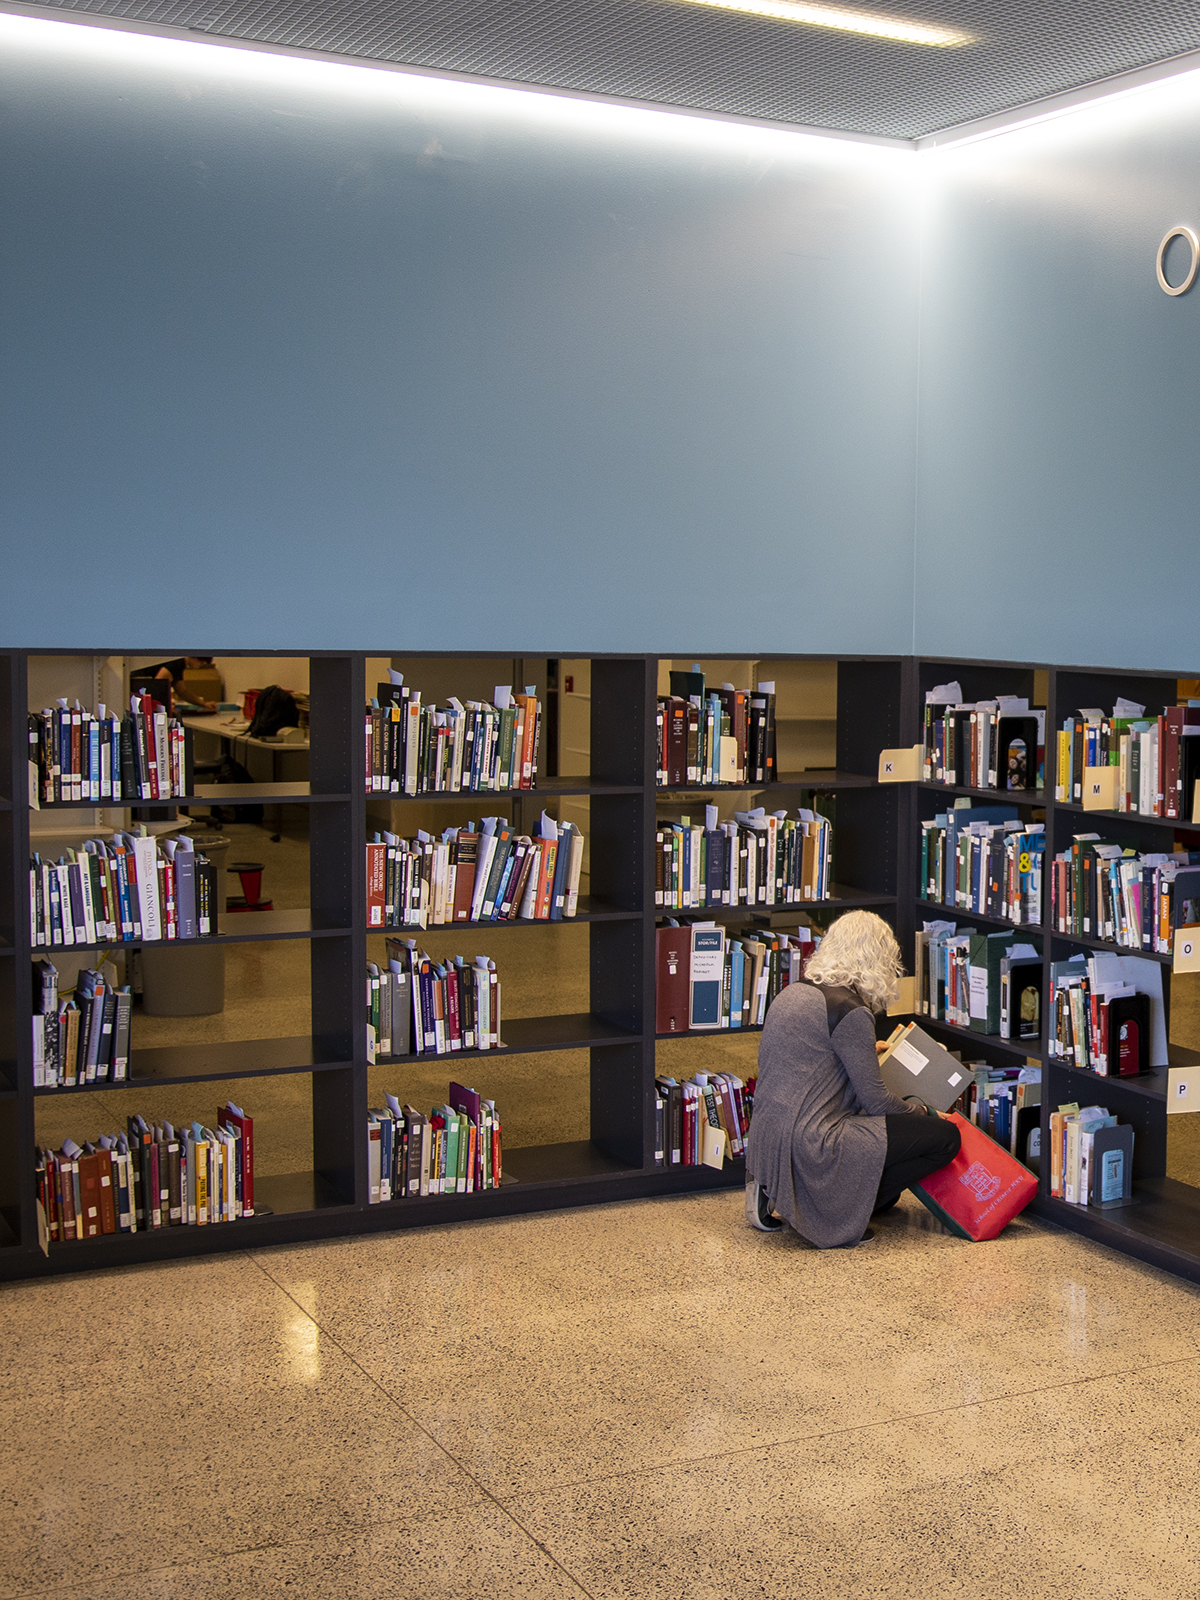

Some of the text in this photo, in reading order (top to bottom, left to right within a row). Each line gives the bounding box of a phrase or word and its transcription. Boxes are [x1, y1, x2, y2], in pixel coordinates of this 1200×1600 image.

[886, 763, 892, 772] K
[146, 851, 154, 876] PHYSICS
[145, 883, 156, 927] GIANCOLI
[1184, 944, 1192, 954] O
[1179, 1084, 1186, 1095] P
[705, 1095, 716, 1108] TEST
